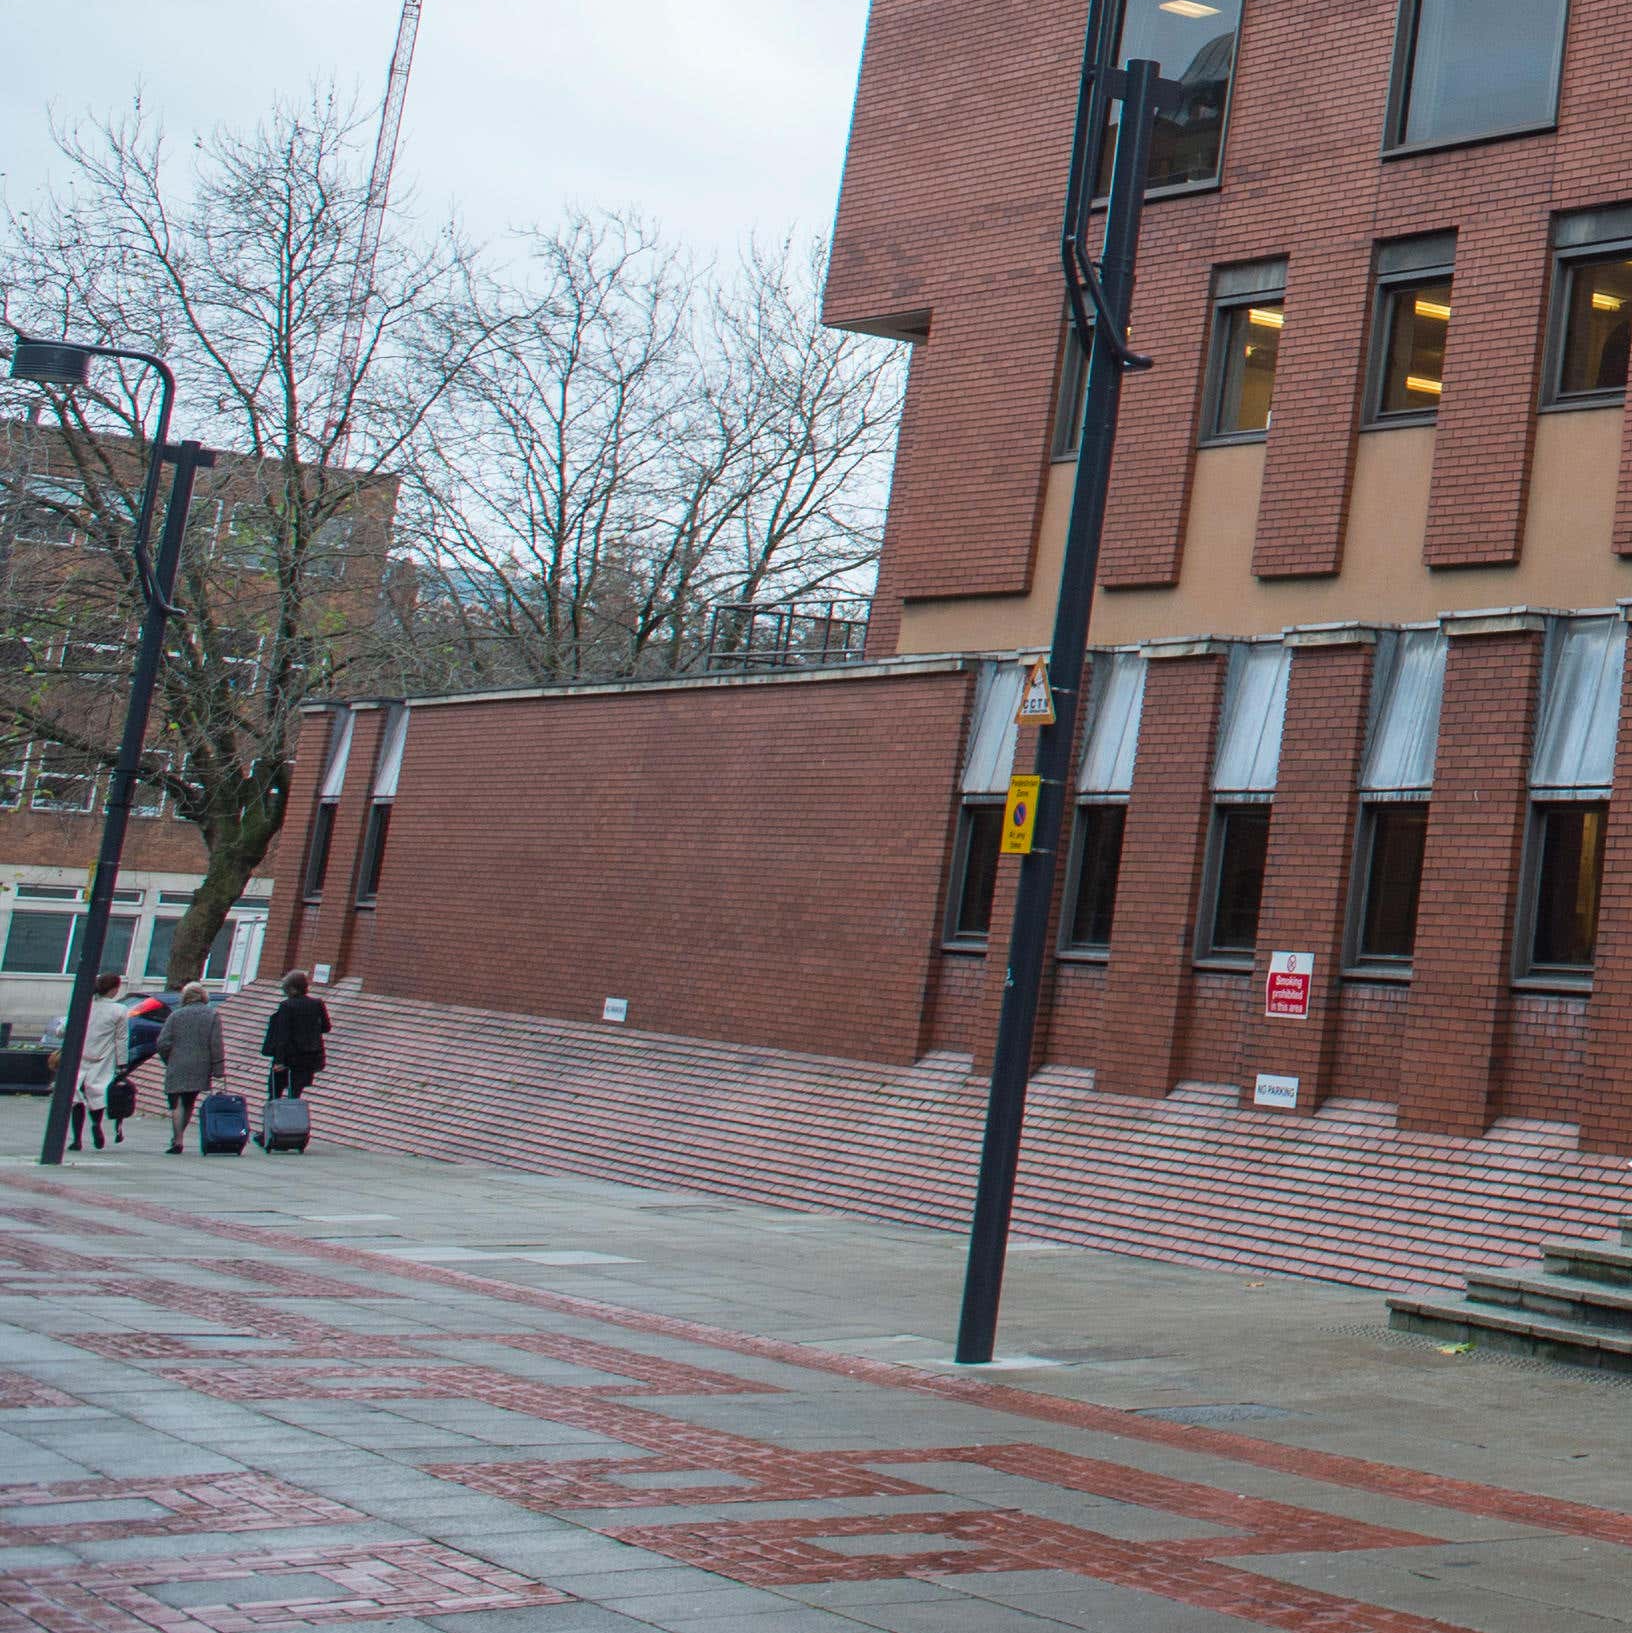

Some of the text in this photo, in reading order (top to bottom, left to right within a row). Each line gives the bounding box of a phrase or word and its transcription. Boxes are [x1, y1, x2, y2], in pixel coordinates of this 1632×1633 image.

[1276, 975, 1302, 989] Smoking
[1272, 989, 1304, 1000] prohibited
[1258, 1084, 1294, 1097] NO PARKING
